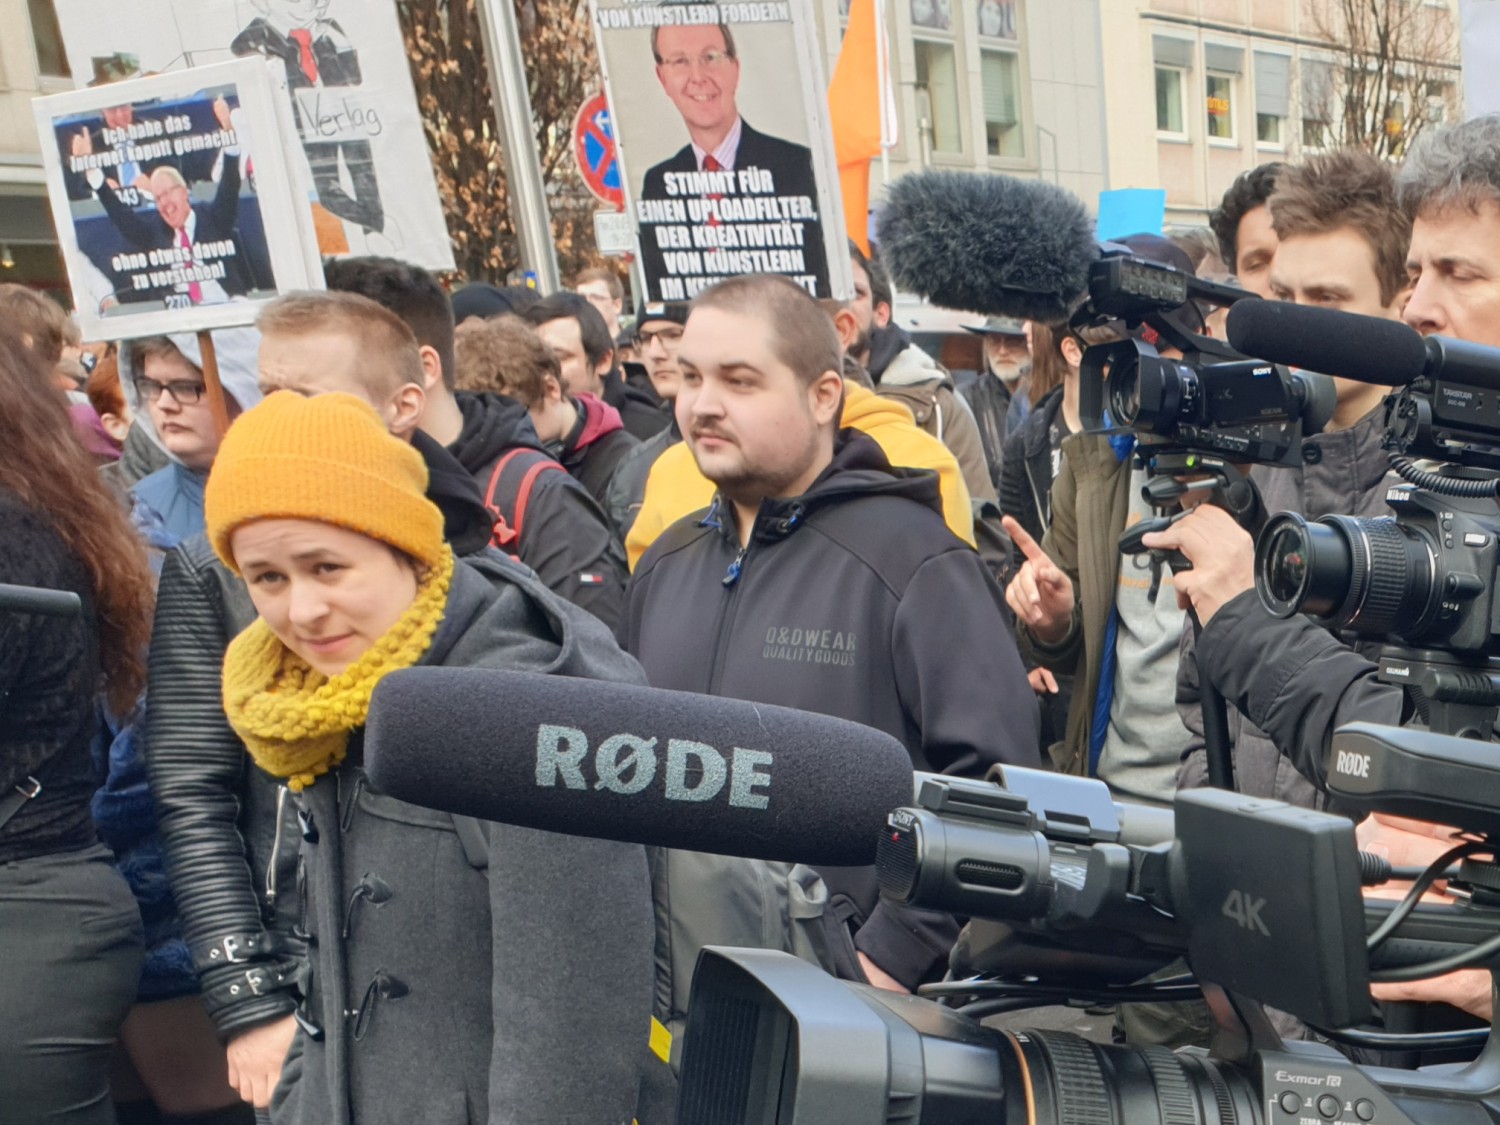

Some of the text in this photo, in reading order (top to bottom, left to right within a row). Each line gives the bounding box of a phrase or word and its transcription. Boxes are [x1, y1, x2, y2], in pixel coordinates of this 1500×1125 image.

[164, 114, 192, 134] das
[299, 93, 382, 137] Verlag
[173, 128, 239, 156] gemacht
[663, 166, 775, 195] STIMMT FÜR
[637, 196, 817, 223] EINEN UPLOADFILTER,
[655, 226, 691, 248] DER
[692, 219, 804, 247] KREATIVITÄT
[112, 239, 236, 272] ohne etwas davon
[663, 248, 806, 275] VON KÜNSTLERN
[132, 274, 149, 290] zu
[660, 278, 686, 300] IM
[1387, 489, 1411, 501] Nikon
[536, 724, 774, 810] RØDE
[1337, 750, 1371, 778] RØDE
[1221, 889, 1271, 937] 4K
